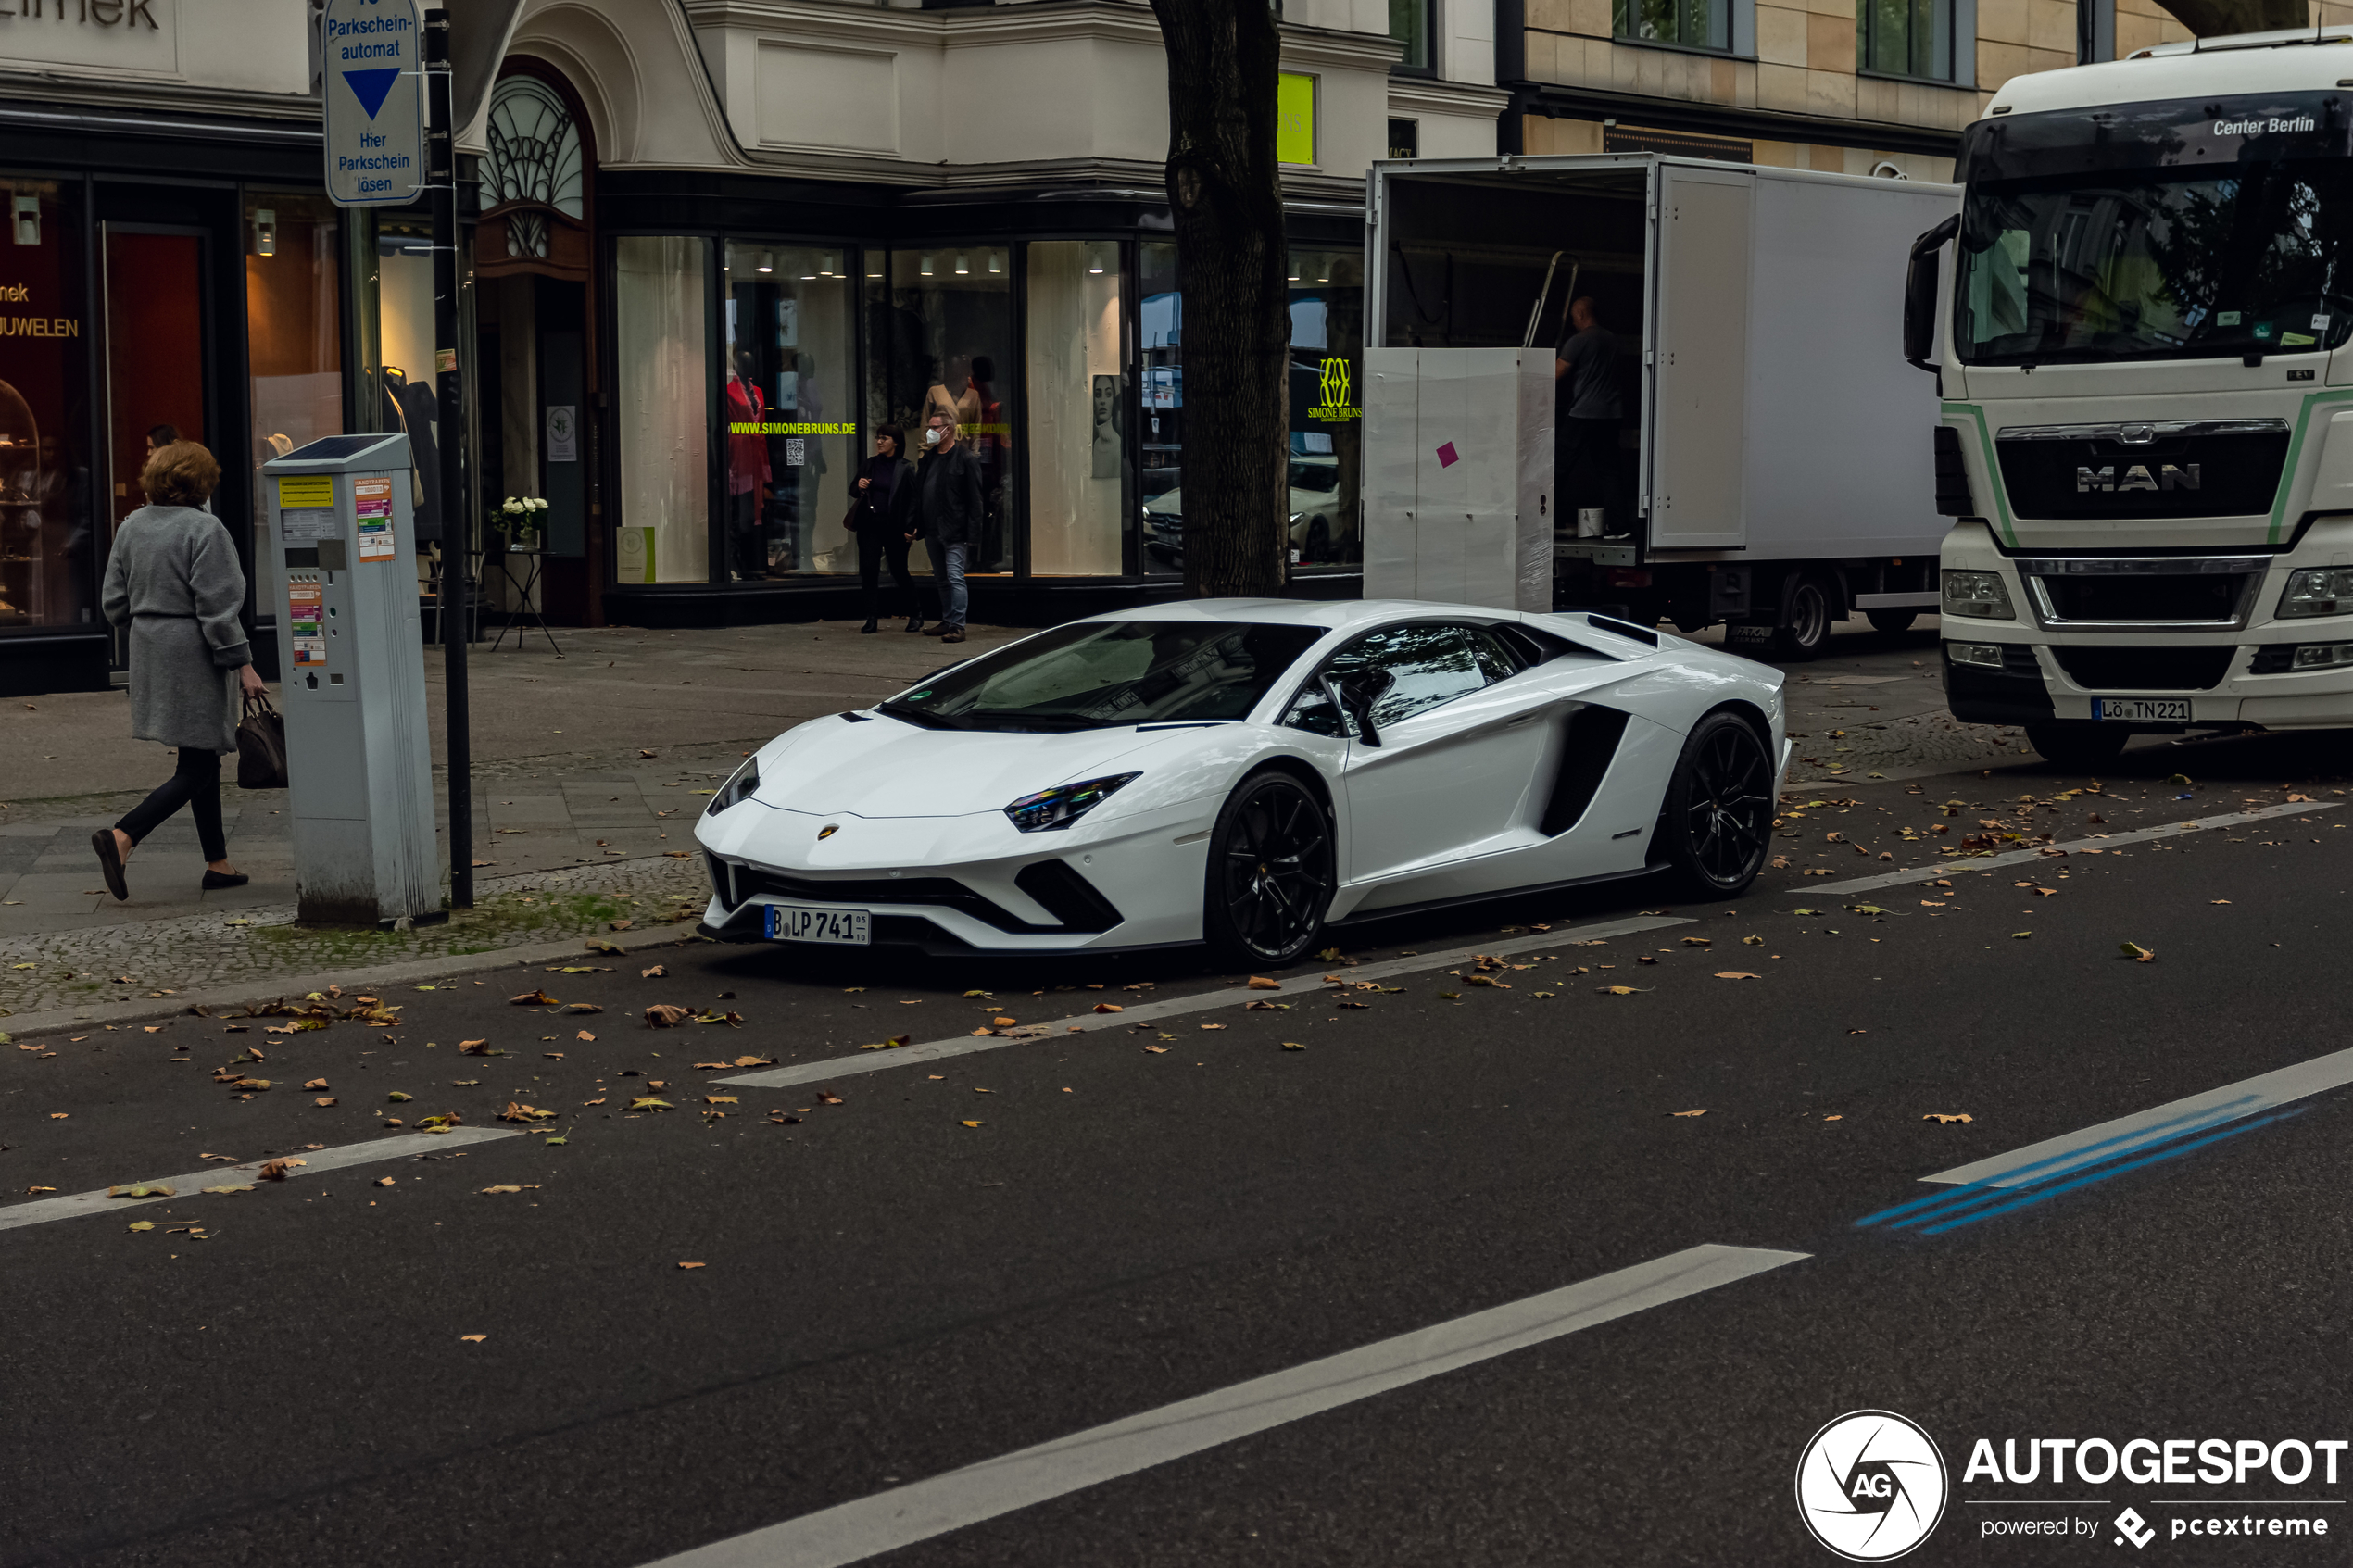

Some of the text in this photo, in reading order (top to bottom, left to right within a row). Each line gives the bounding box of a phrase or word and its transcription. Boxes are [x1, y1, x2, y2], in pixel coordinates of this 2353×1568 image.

[328, 14, 412, 36] Parkschein-
[341, 39, 400, 60] automat
[2213, 116, 2315, 136] Center Berlin
[359, 132, 386, 148] Hier
[338, 153, 409, 171] Parkschein
[357, 176, 393, 193] lösen
[1308, 407, 1363, 418] SIMONE BRUNS
[730, 422, 856, 434] WWW.SIMONEBRUNS.DE
[2077, 463, 2201, 492] MAN
[2102, 701, 2123, 718] LÖ
[774, 909, 782, 935] B
